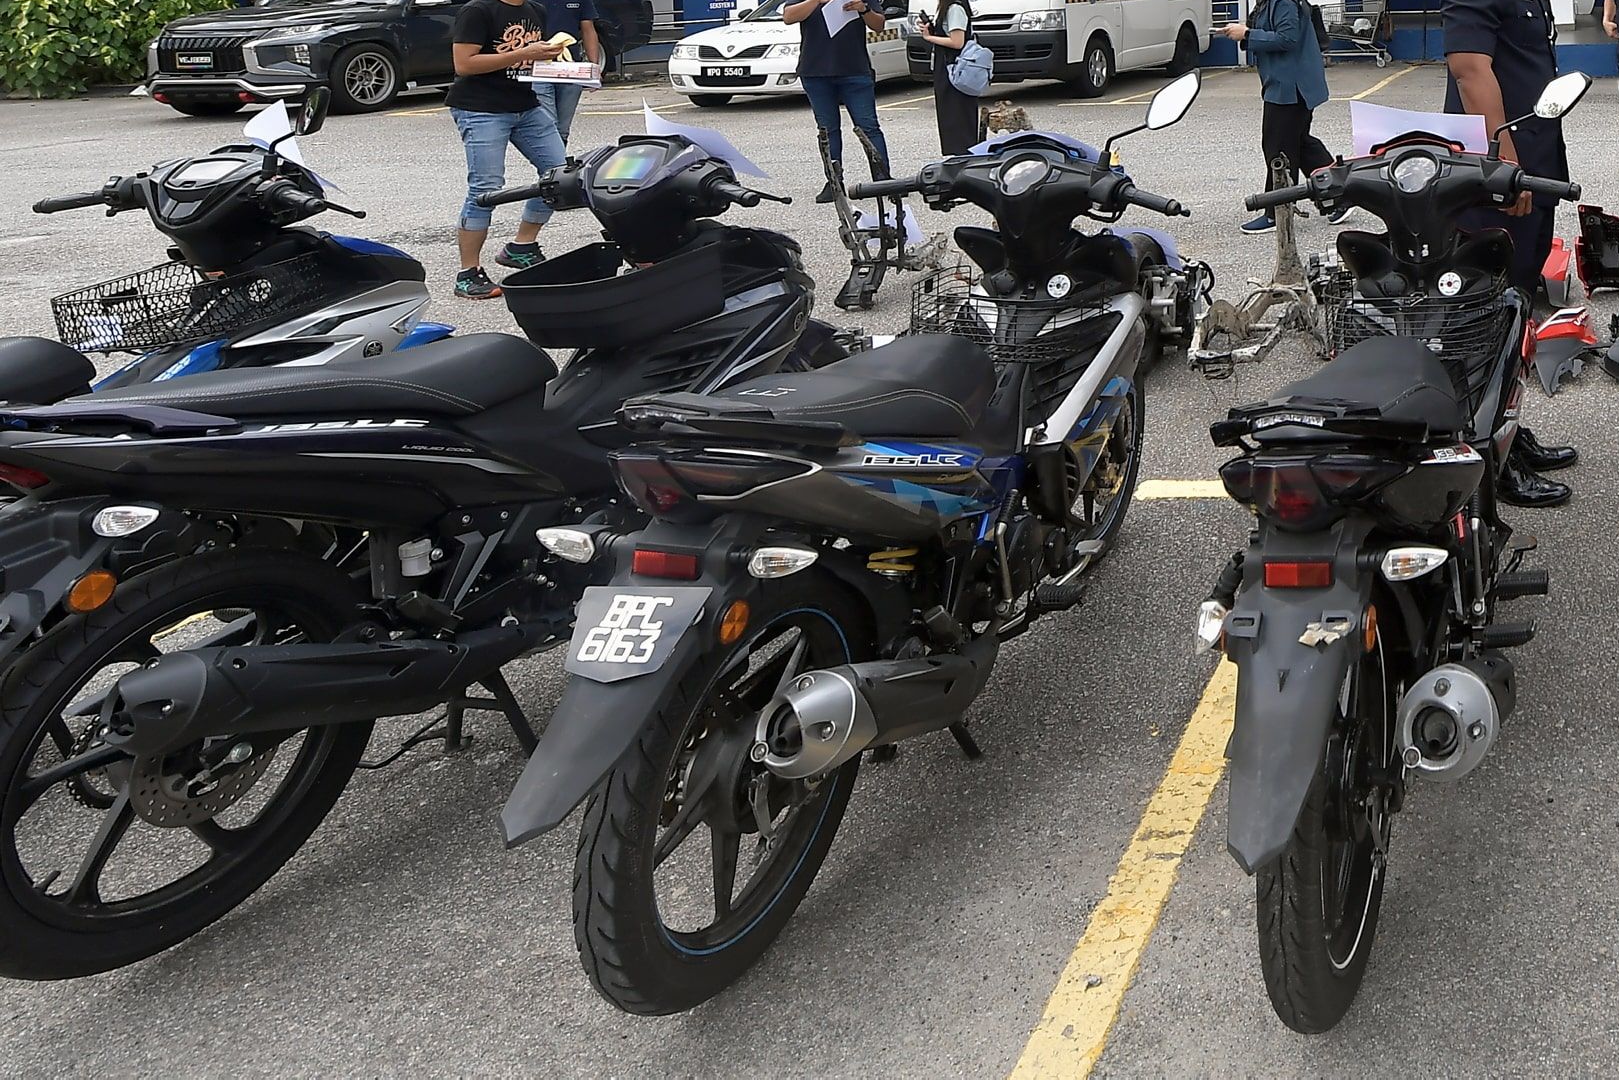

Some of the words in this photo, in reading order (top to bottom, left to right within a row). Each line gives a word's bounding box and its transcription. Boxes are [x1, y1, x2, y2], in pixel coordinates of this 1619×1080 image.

[709, 2, 731, 10] SEKSYEN
[723, 67, 744, 76] 5540
[861, 453, 963, 468] 135LC
[598, 594, 674, 630] BPC
[576, 626, 662, 664] 6163
